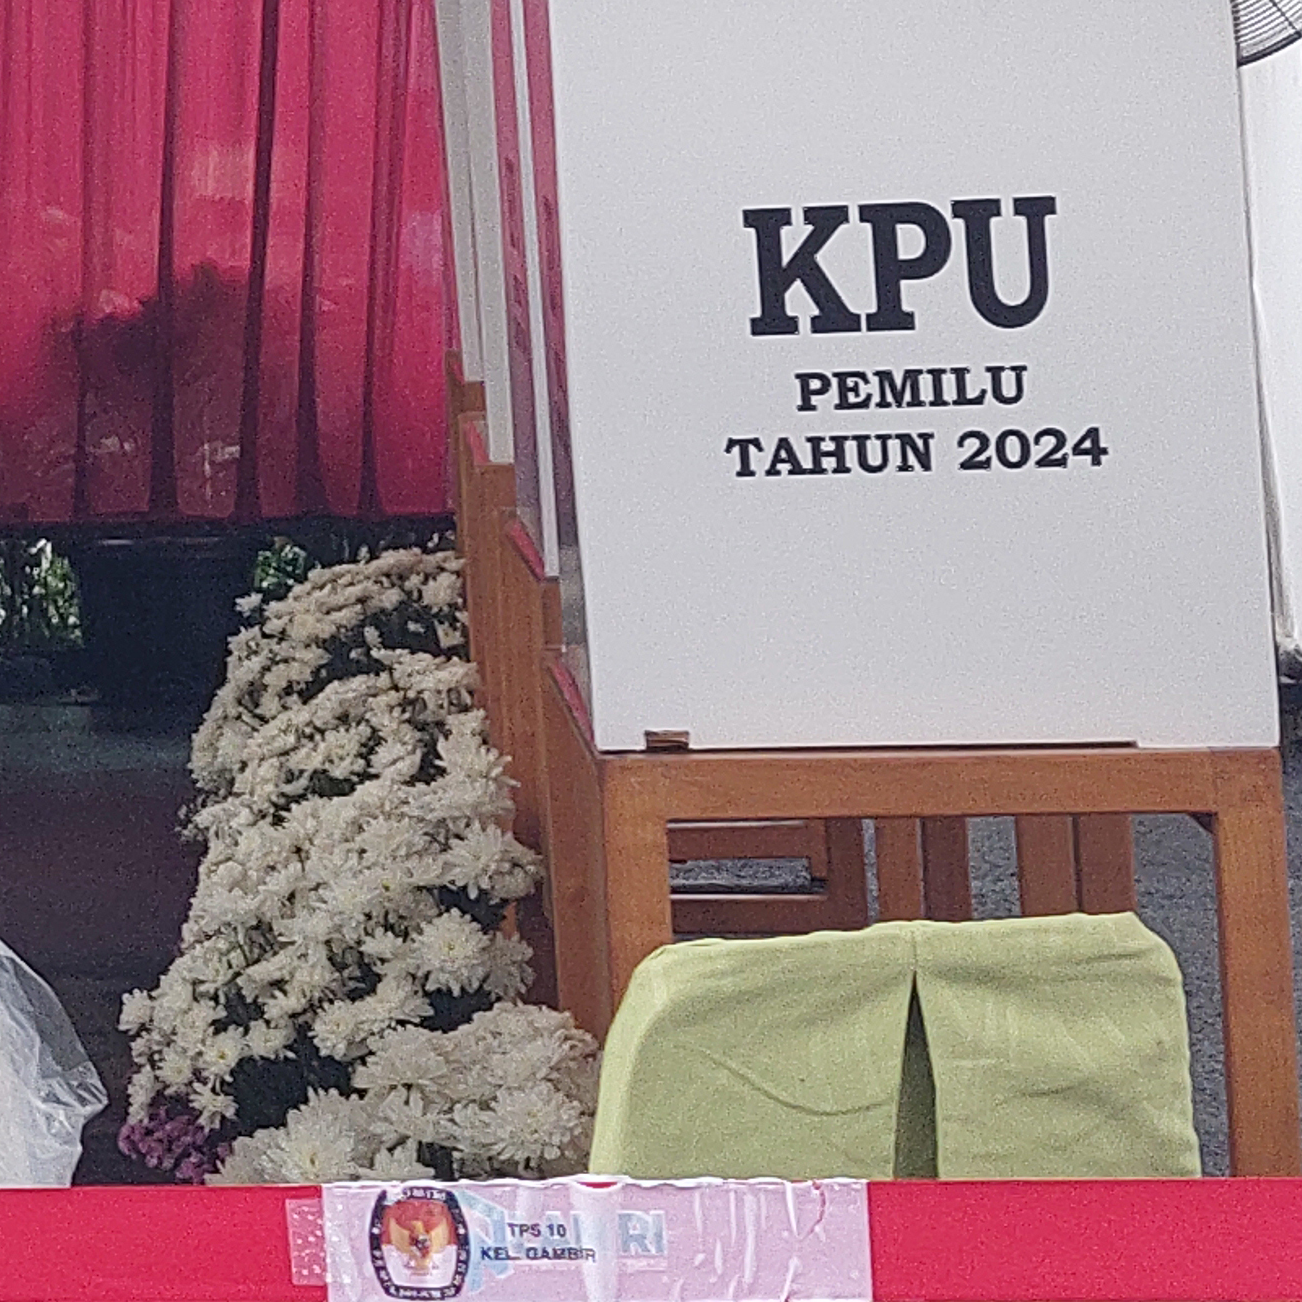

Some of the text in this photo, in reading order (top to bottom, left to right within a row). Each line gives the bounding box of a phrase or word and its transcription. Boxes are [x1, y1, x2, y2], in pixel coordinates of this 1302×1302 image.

[742, 195, 1057, 337] KPU
[794, 364, 1028, 412] PEMILU
[723, 426, 1109, 478] TAHUN 2024
[507, 1222, 566, 1239] TPS 10
